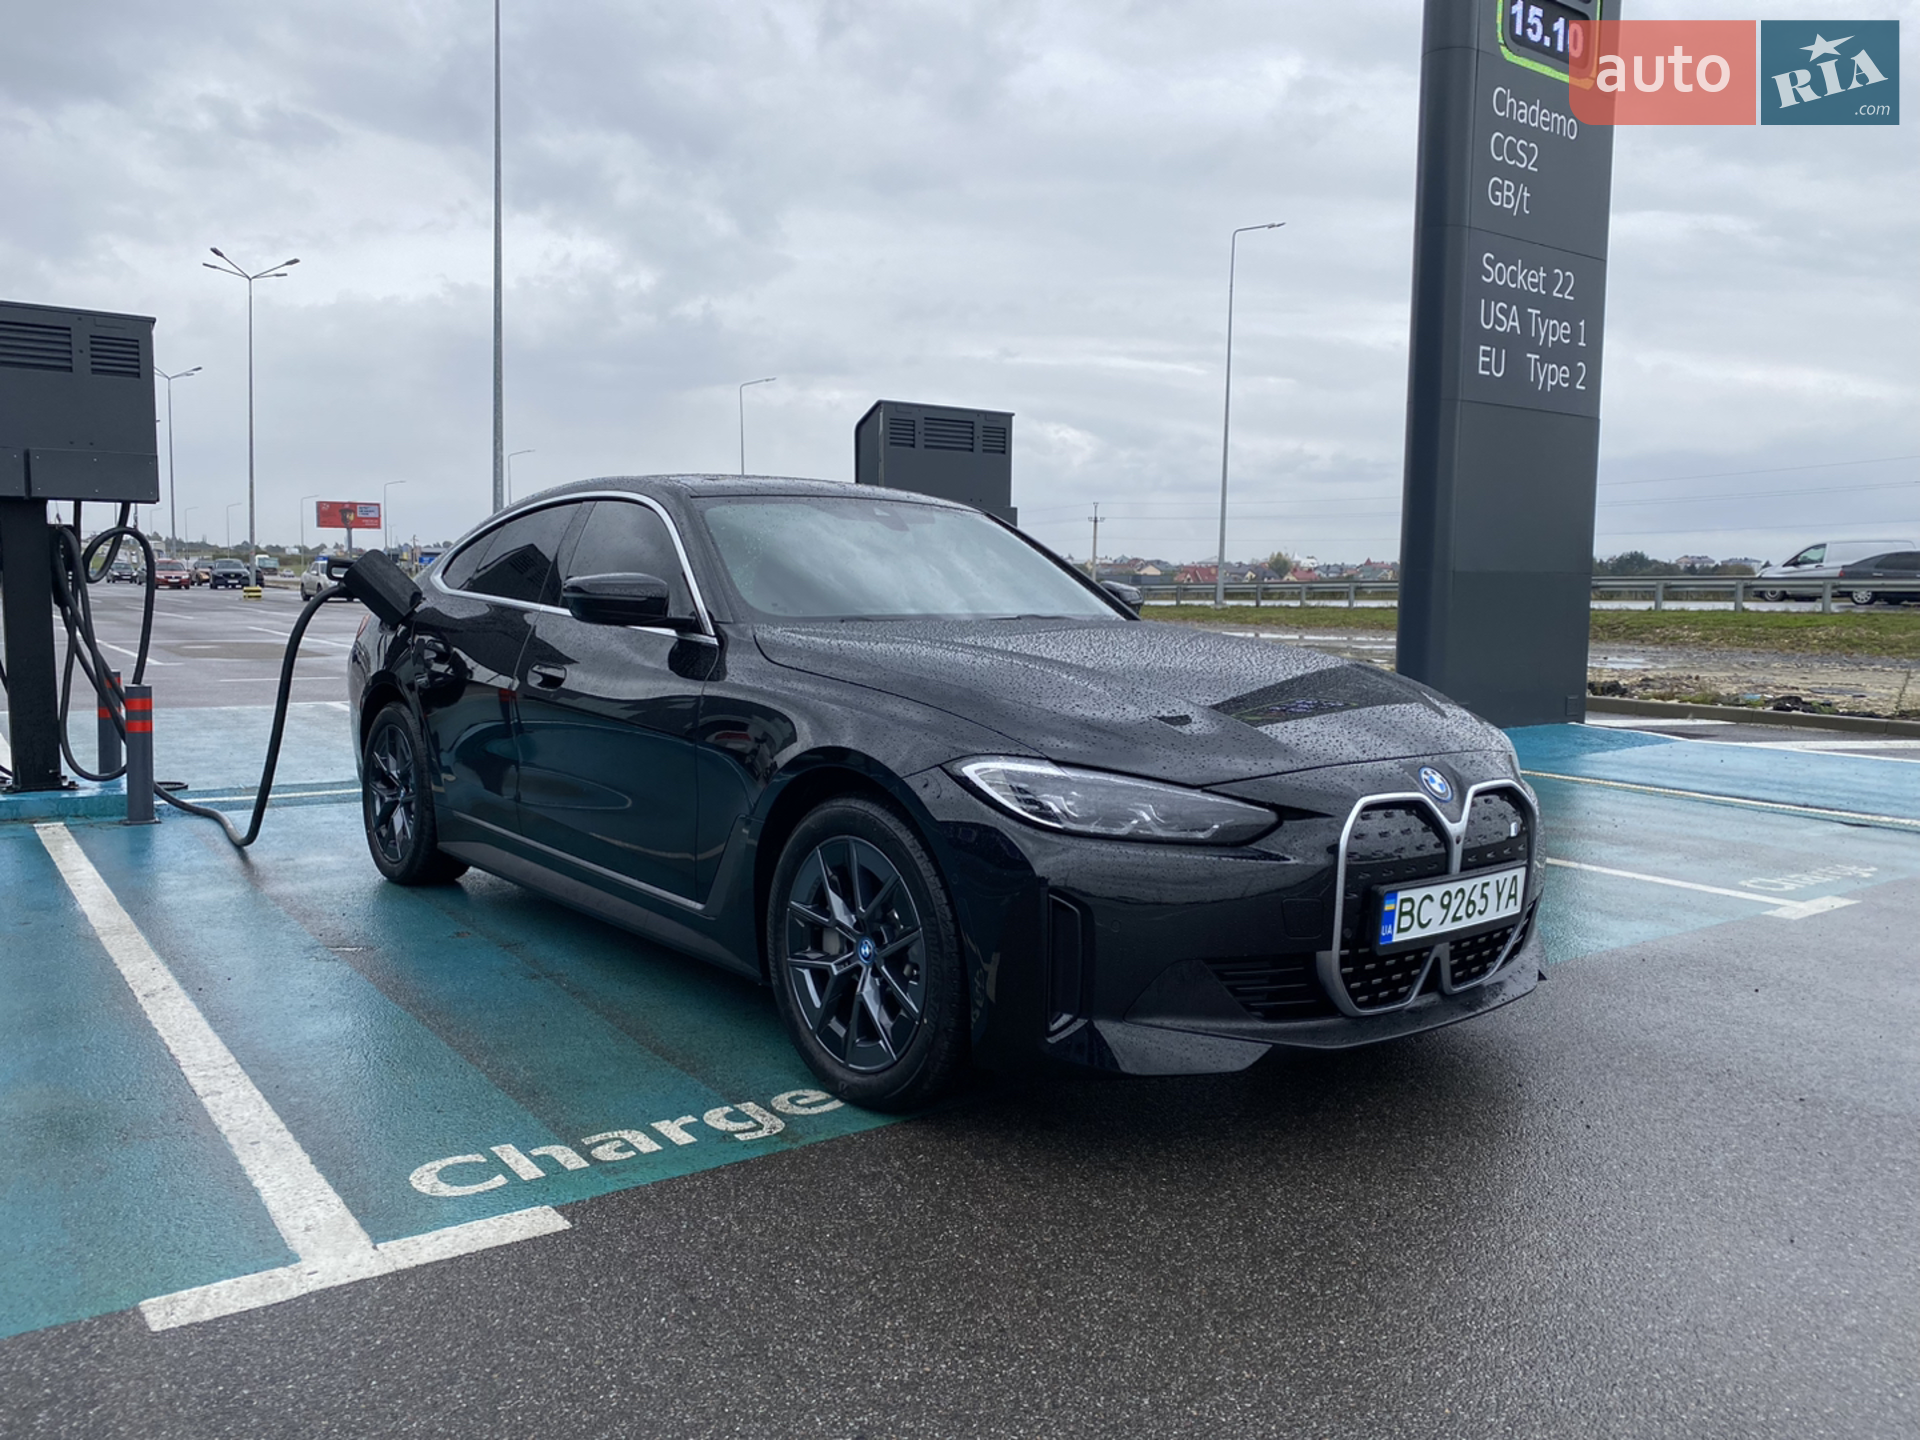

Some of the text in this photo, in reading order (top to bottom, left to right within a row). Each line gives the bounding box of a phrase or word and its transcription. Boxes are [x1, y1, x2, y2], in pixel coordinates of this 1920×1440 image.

[1511, 0, 1584, 58] 15.10
[1492, 86, 1578, 140] Chademo
[1490, 132, 1539, 172] CCS2
[1487, 176, 1531, 216] GB/t
[1481, 252, 1575, 301] Socket 22
[1480, 299, 1587, 347] USA Type 1
[1477, 345, 1587, 391] EU Type 2
[1396, 874, 1519, 934] BC 9265 YA
[1381, 924, 1393, 936] UA
[409, 1088, 845, 1197] Charge
